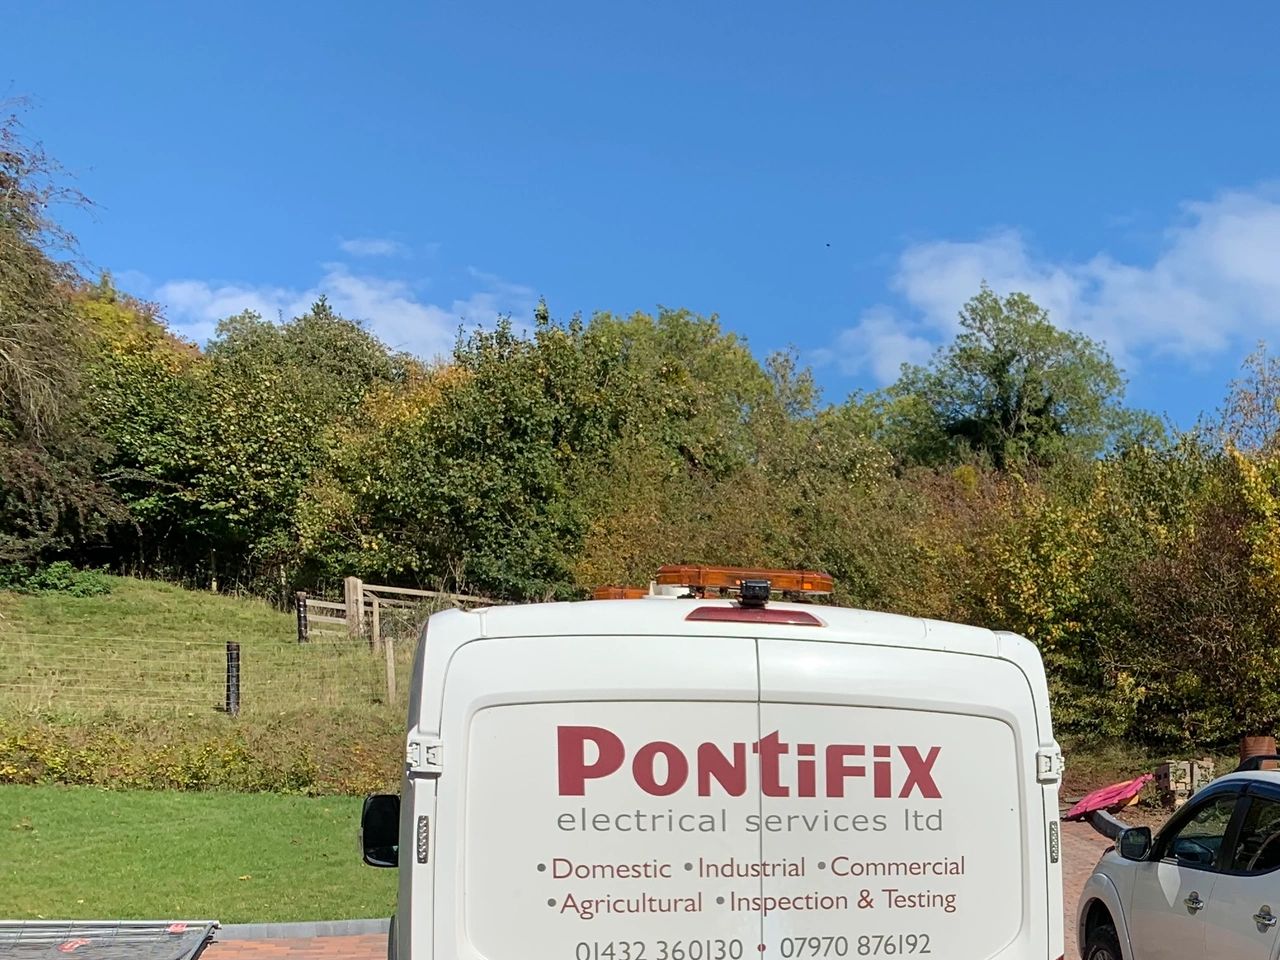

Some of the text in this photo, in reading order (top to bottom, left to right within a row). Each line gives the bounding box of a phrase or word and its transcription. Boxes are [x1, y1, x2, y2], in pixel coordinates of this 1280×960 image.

[557, 808, 943, 833] electrical services ltd
[552, 855, 965, 879] Domestic Industrial Commercial
[560, 888, 957, 920] Agricultural Inspection & Testing
[780, 935, 849, 959] 07970
[856, 933, 932, 956] 876192
